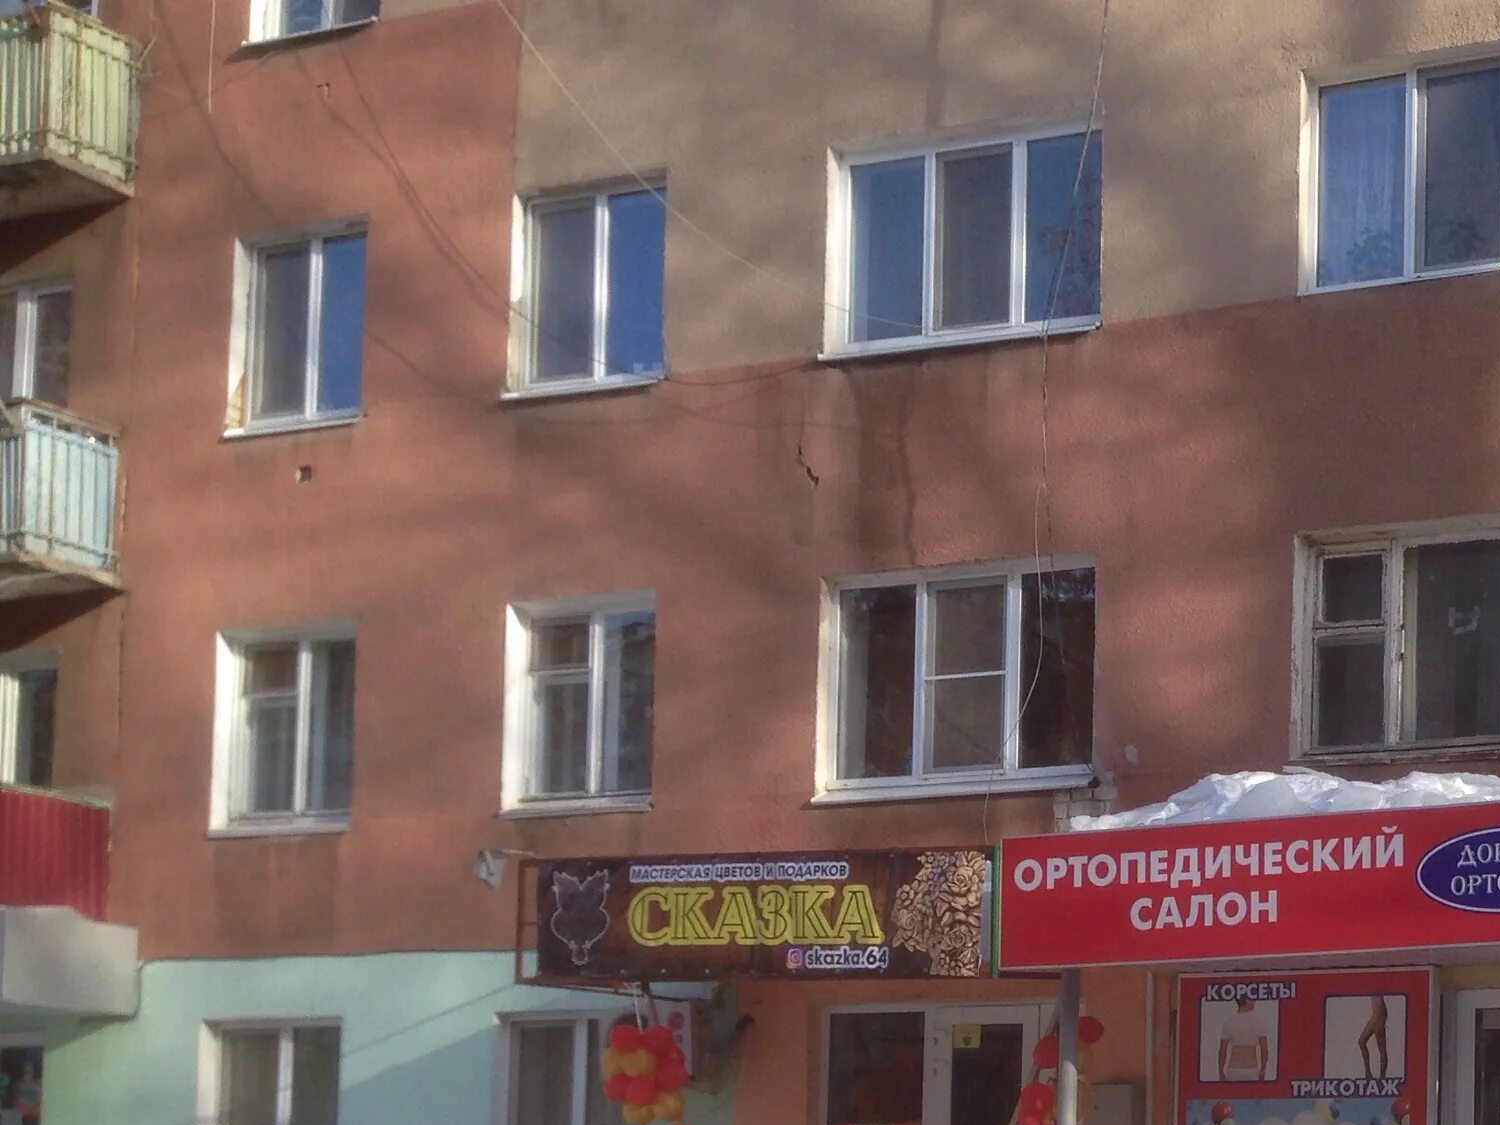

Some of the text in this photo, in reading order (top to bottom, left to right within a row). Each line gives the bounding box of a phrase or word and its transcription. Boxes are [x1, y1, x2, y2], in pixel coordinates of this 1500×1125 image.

[1013, 826, 1405, 892] ОРТОПЕДИЧЕСКИЙ
[630, 862, 848, 882] МАСТЕРСКАЯ ЦВЕТОВ И ПОДАРКОВ
[629, 886, 884, 945] СКАЗКА
[1129, 889, 1279, 932] САЛОН
[805, 948, 889, 968] skazka.64
[1207, 983, 1297, 1000] КОРСЕТЫ
[1291, 1080, 1400, 1097] ТРИКОТАЖ
